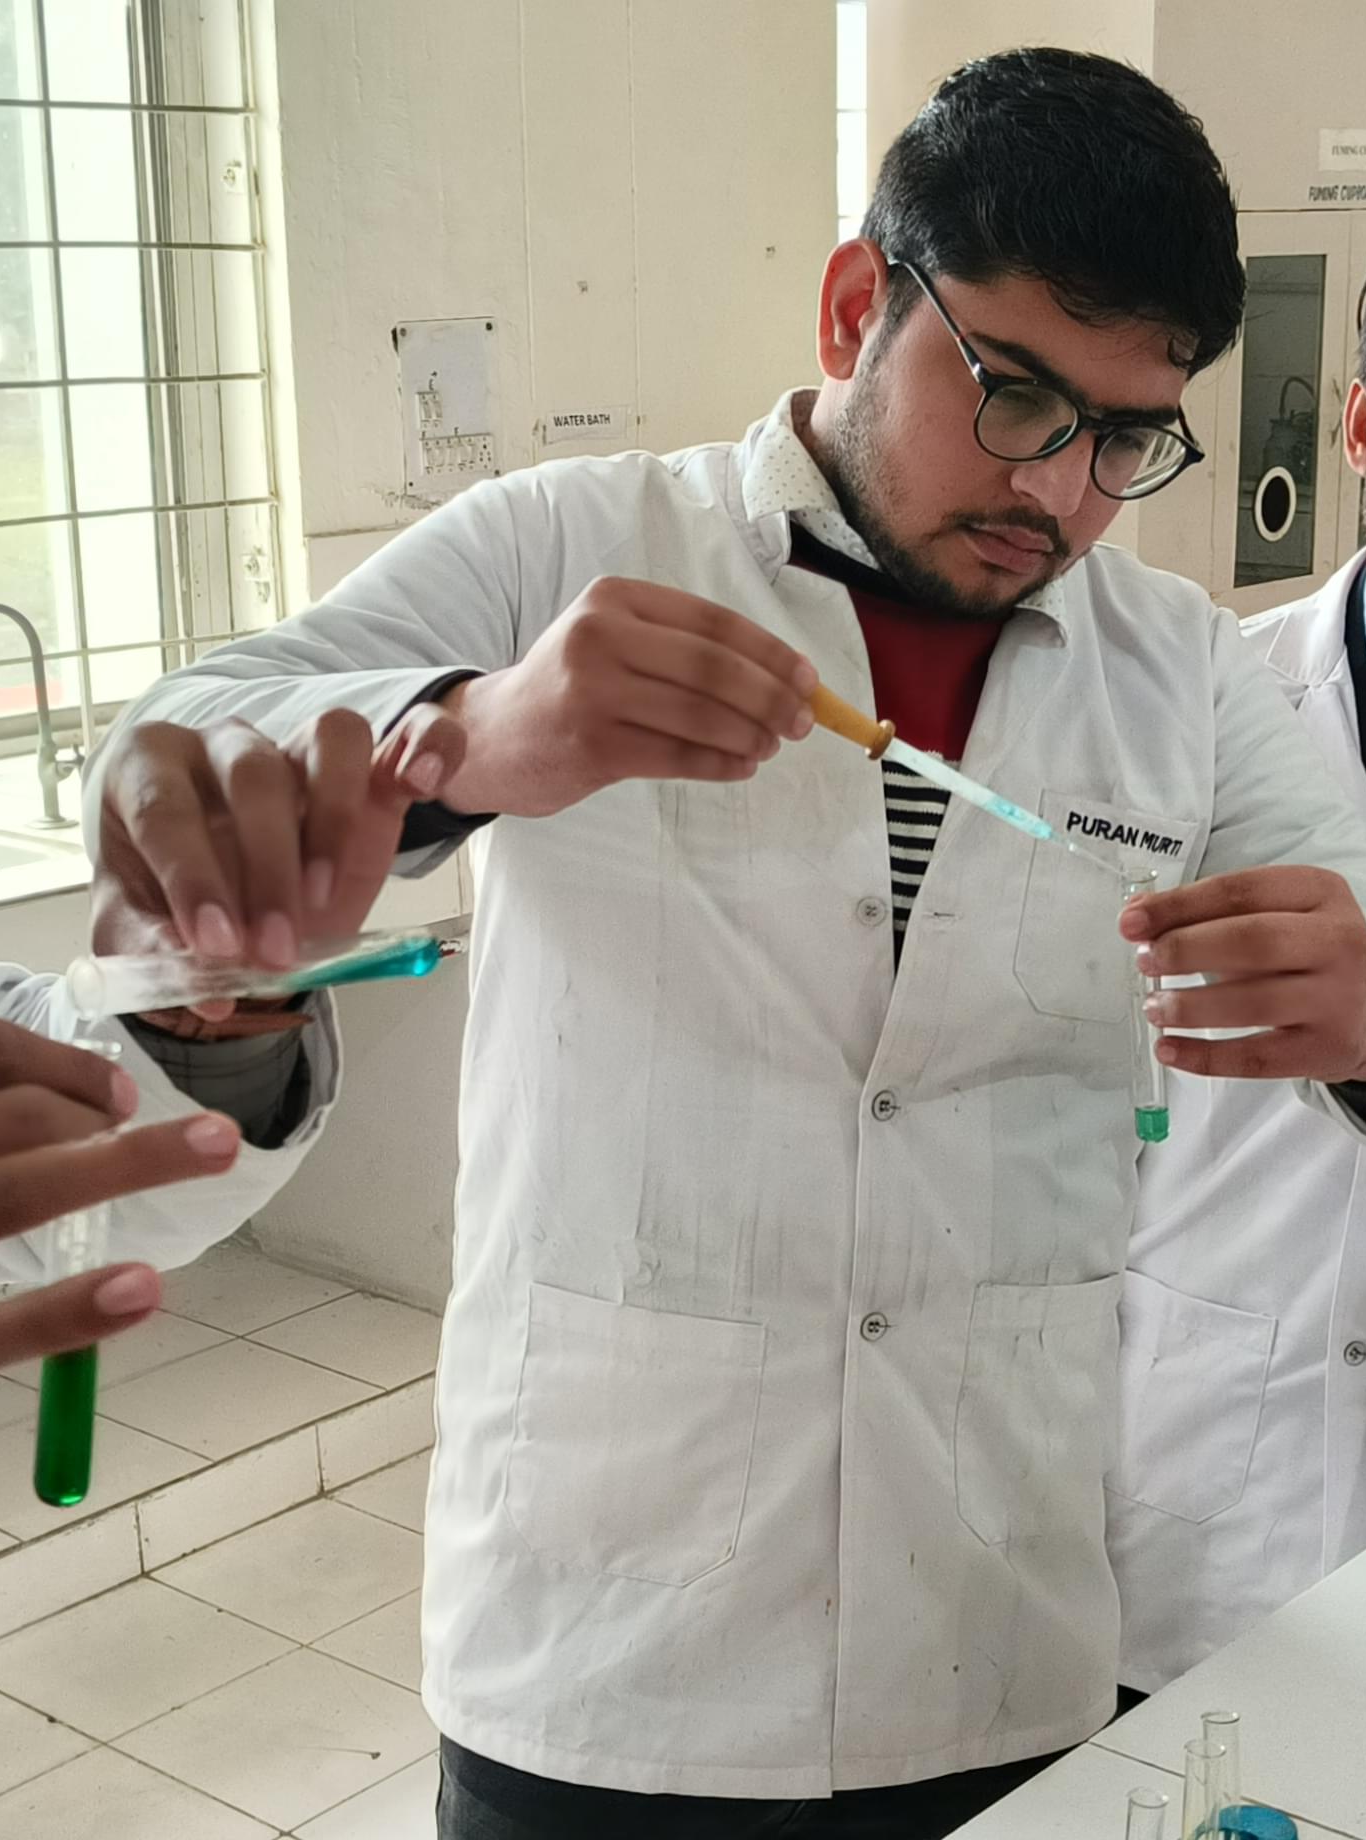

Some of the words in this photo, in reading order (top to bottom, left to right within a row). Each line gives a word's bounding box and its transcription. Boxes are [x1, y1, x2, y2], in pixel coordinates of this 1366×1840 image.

[1308, 185, 1339, 201] FUMING
[553, 415, 586, 427] WATER
[587, 413, 611, 426] BATH
[1066, 810, 1140, 847] PURAN
[1139, 830, 1184, 857] MURTI
